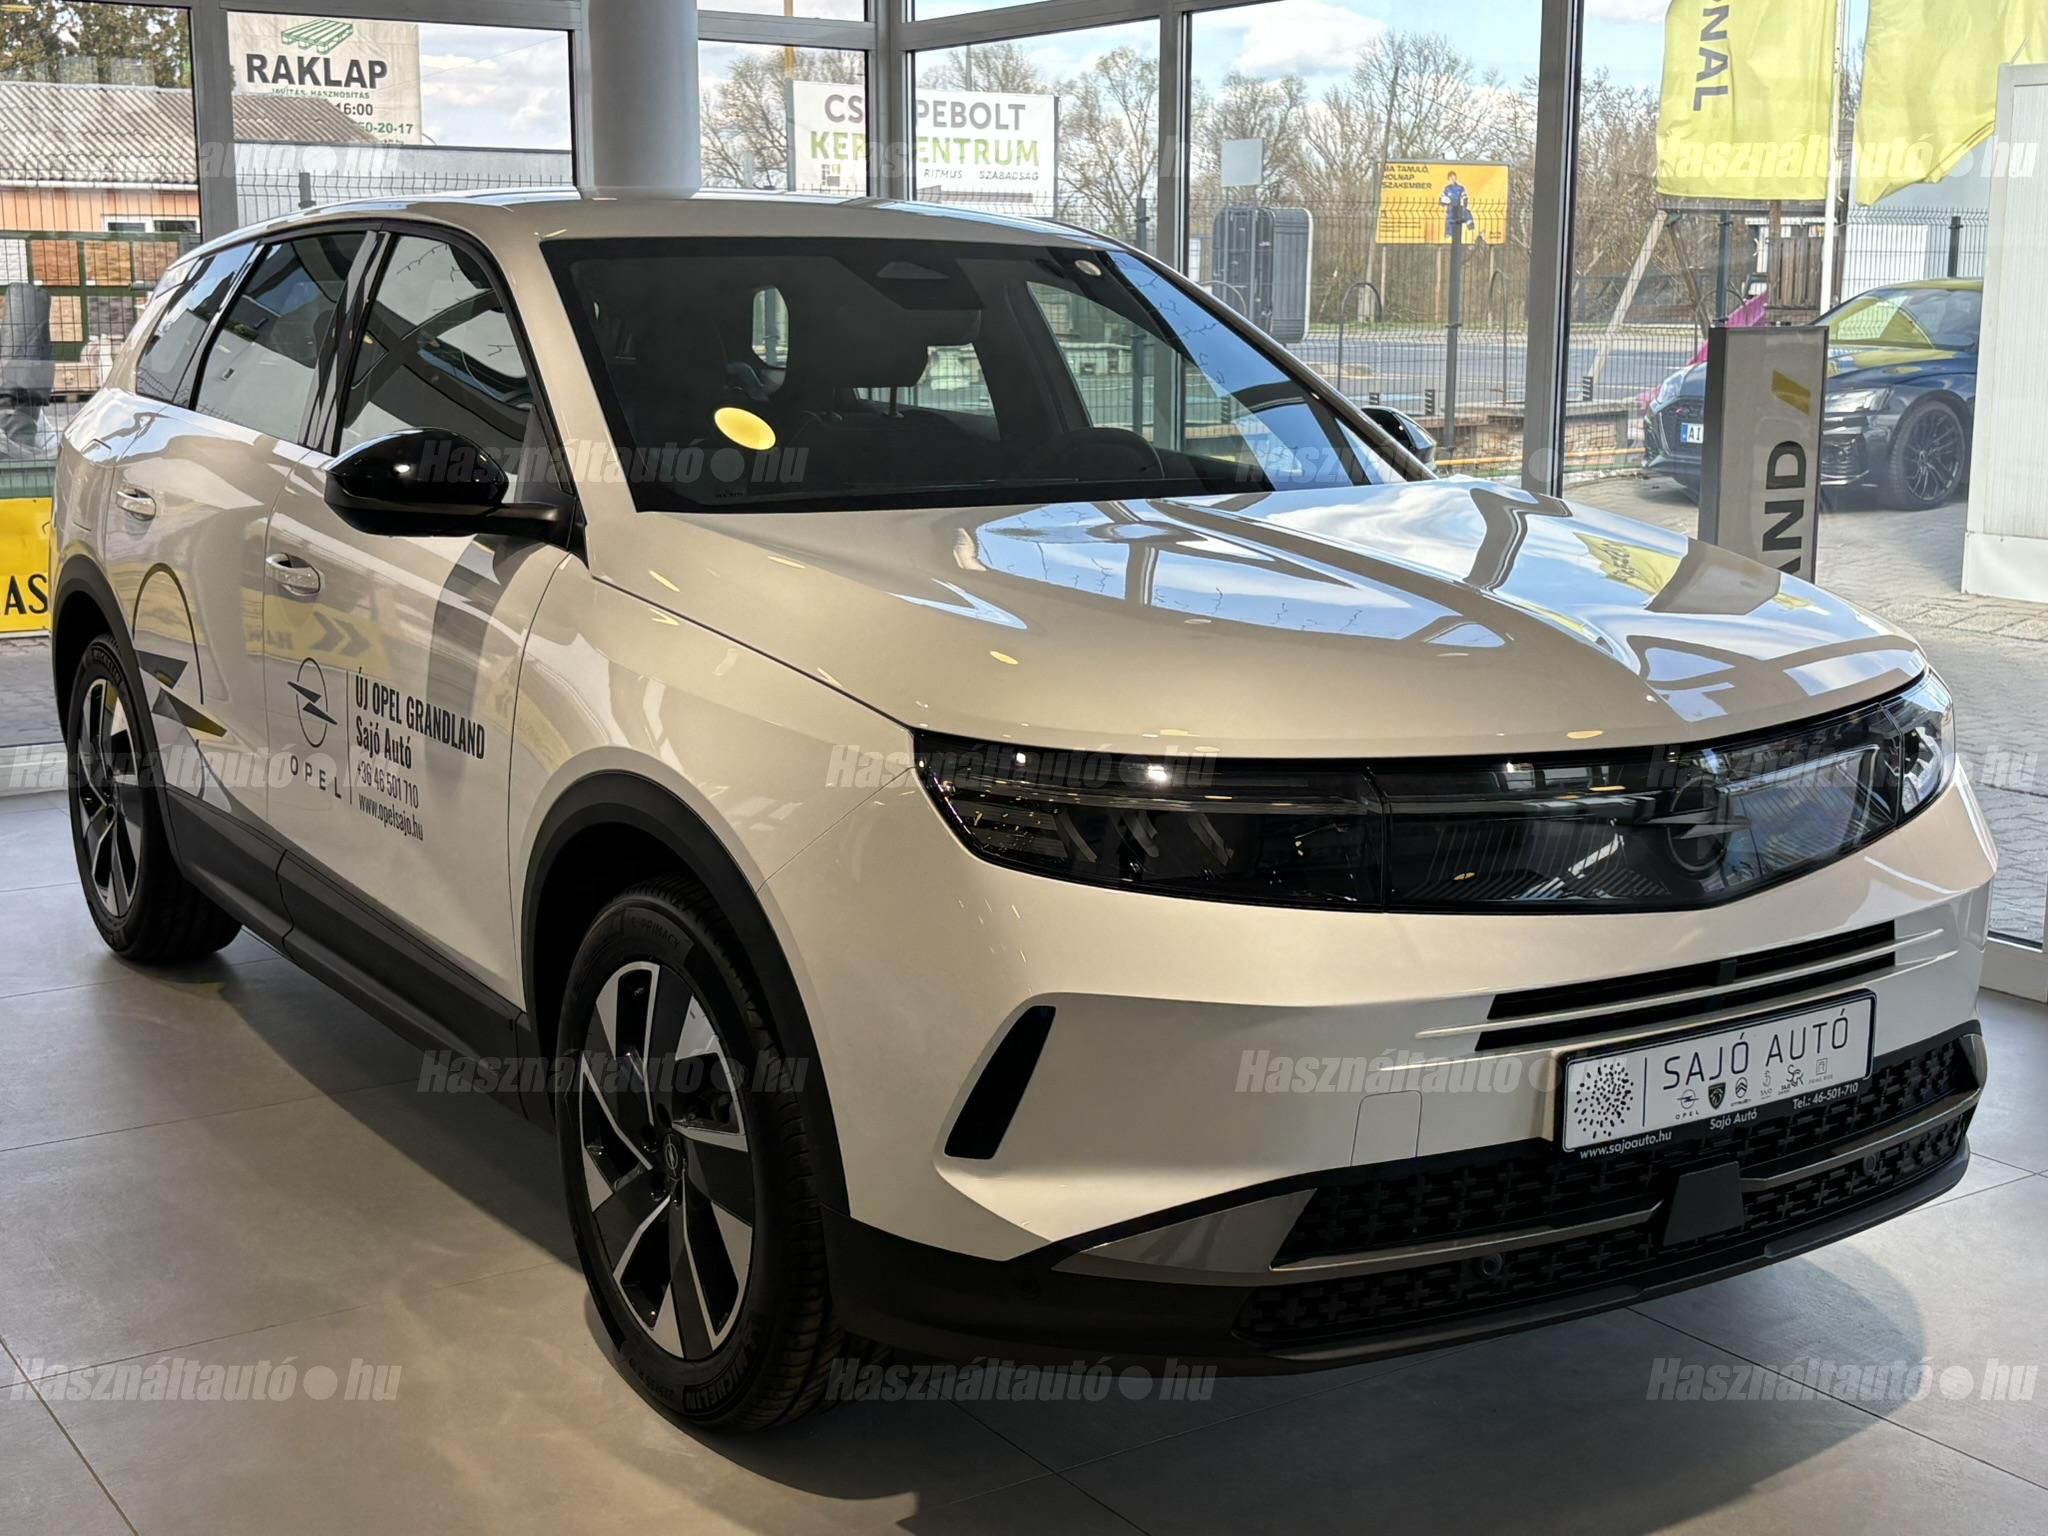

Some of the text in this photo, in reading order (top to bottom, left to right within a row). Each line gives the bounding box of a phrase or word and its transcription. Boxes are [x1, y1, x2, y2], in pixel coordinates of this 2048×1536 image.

[246, 53, 388, 89] RAKLAP
[1692, 0, 1730, 111] NAL
[824, 94, 1026, 131] CSPEBOLT
[810, 130, 1040, 168] KERENTRUM
[924, 168, 963, 180] RITMUS
[355, 667, 486, 759] ÚJ OPEL GRANDLAND
[356, 715, 412, 769] Sajó Autó
[289, 755, 342, 799] OPEL
[357, 760, 419, 808] +36 46 501 710
[358, 793, 424, 841] www.opelsajo.hu
[1663, 1008, 1849, 1090] SAJÓ AUTÓ
[1812, 1082, 1859, 1104] 46-501-710
[1675, 1110, 1700, 1120] OPEL
[1709, 1109, 1758, 1131] Sajó Autó
[1579, 1130, 1672, 1160] www.sajoauto.hu
